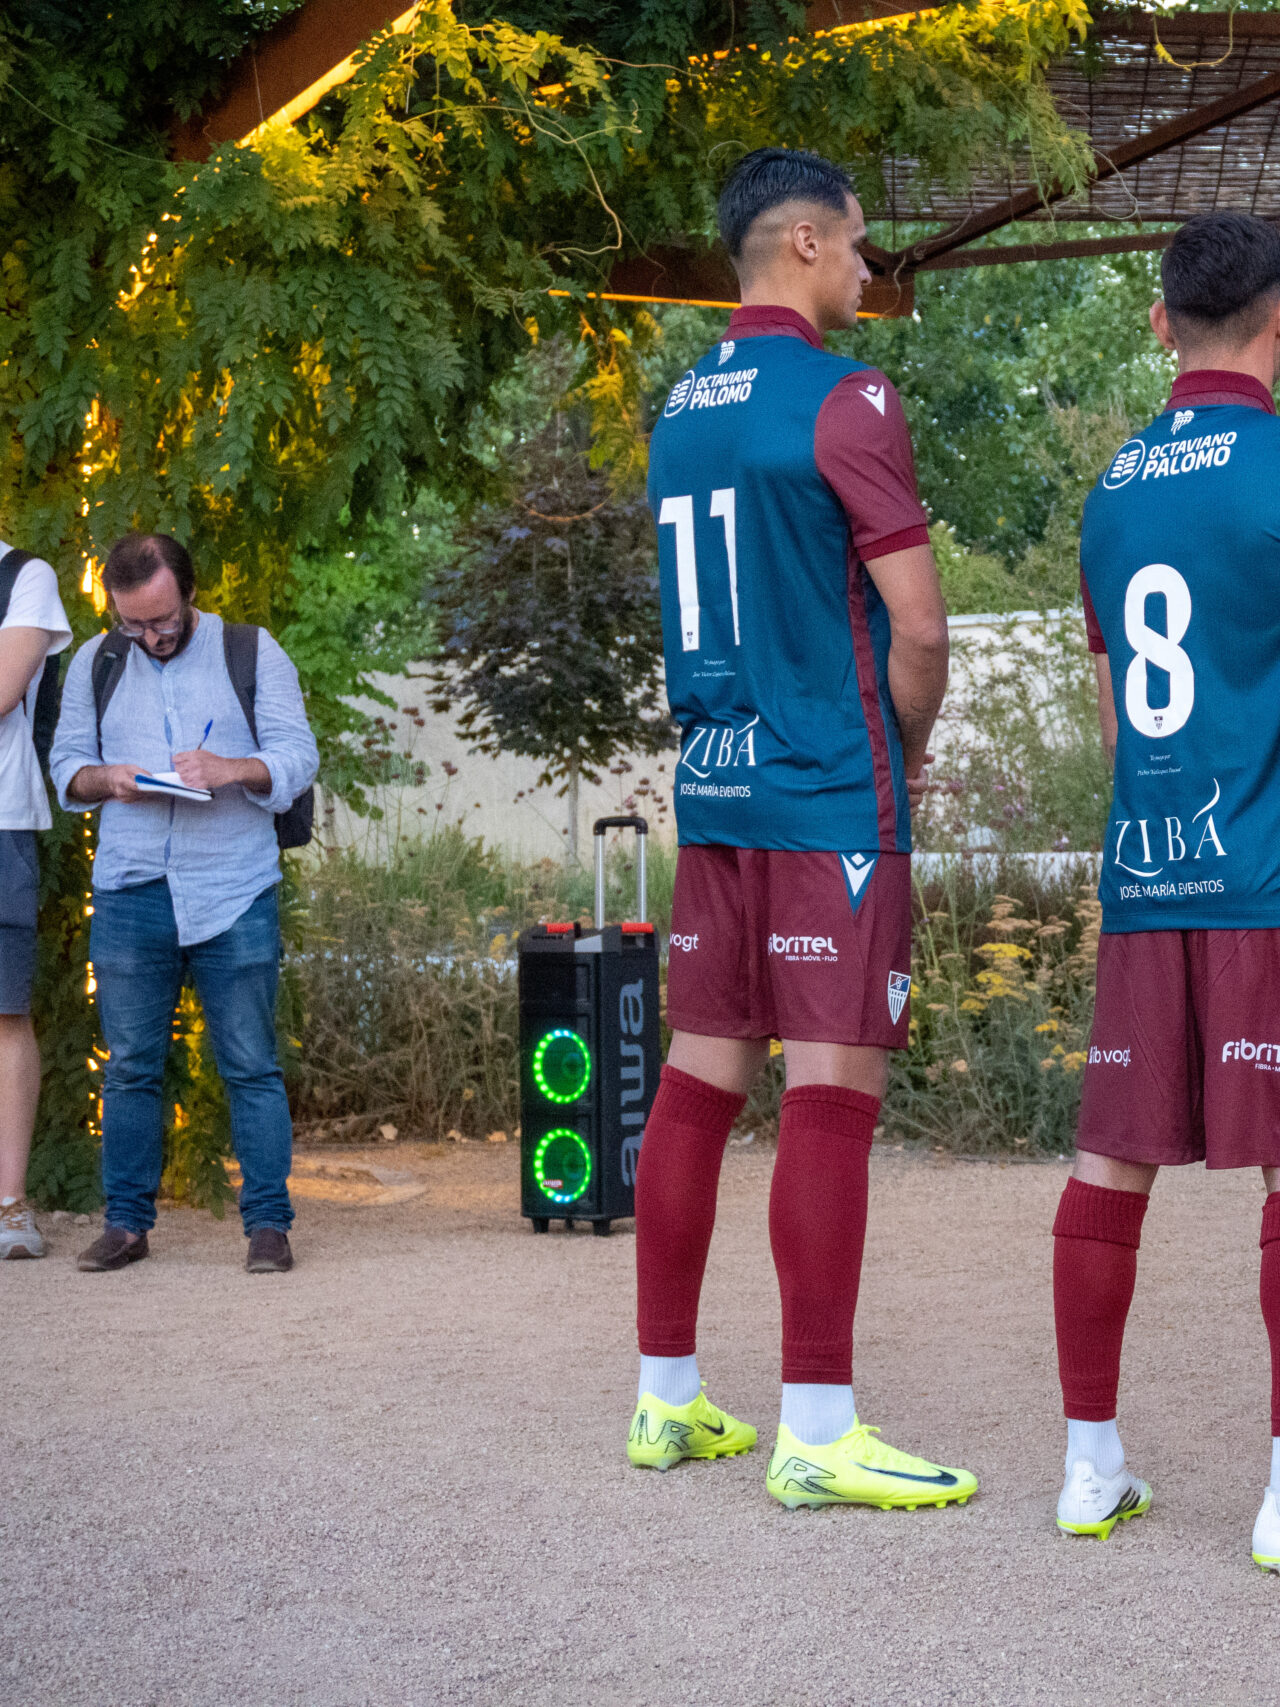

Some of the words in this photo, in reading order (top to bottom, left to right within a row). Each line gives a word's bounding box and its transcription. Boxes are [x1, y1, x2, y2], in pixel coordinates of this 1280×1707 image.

[696, 368, 758, 390] OCTAVIANO
[689, 381, 752, 410] PALOMO
[1148, 431, 1238, 460] OCTAVIANO
[1141, 445, 1231, 481] PALOMO
[658, 487, 741, 652] 11
[1124, 563, 1195, 738] 8
[681, 714, 759, 779] ZIBÁ
[680, 782, 696, 796] JOSÉ
[697, 783, 718, 797] MARÍA
[719, 785, 751, 798] EVENTOS
[1114, 777, 1228, 877] ZIBÁ
[1120, 883, 1142, 900] JOSÉ
[1142, 881, 1176, 898] MARÍA
[1254, 1063, 1272, 1071] FIBRA
